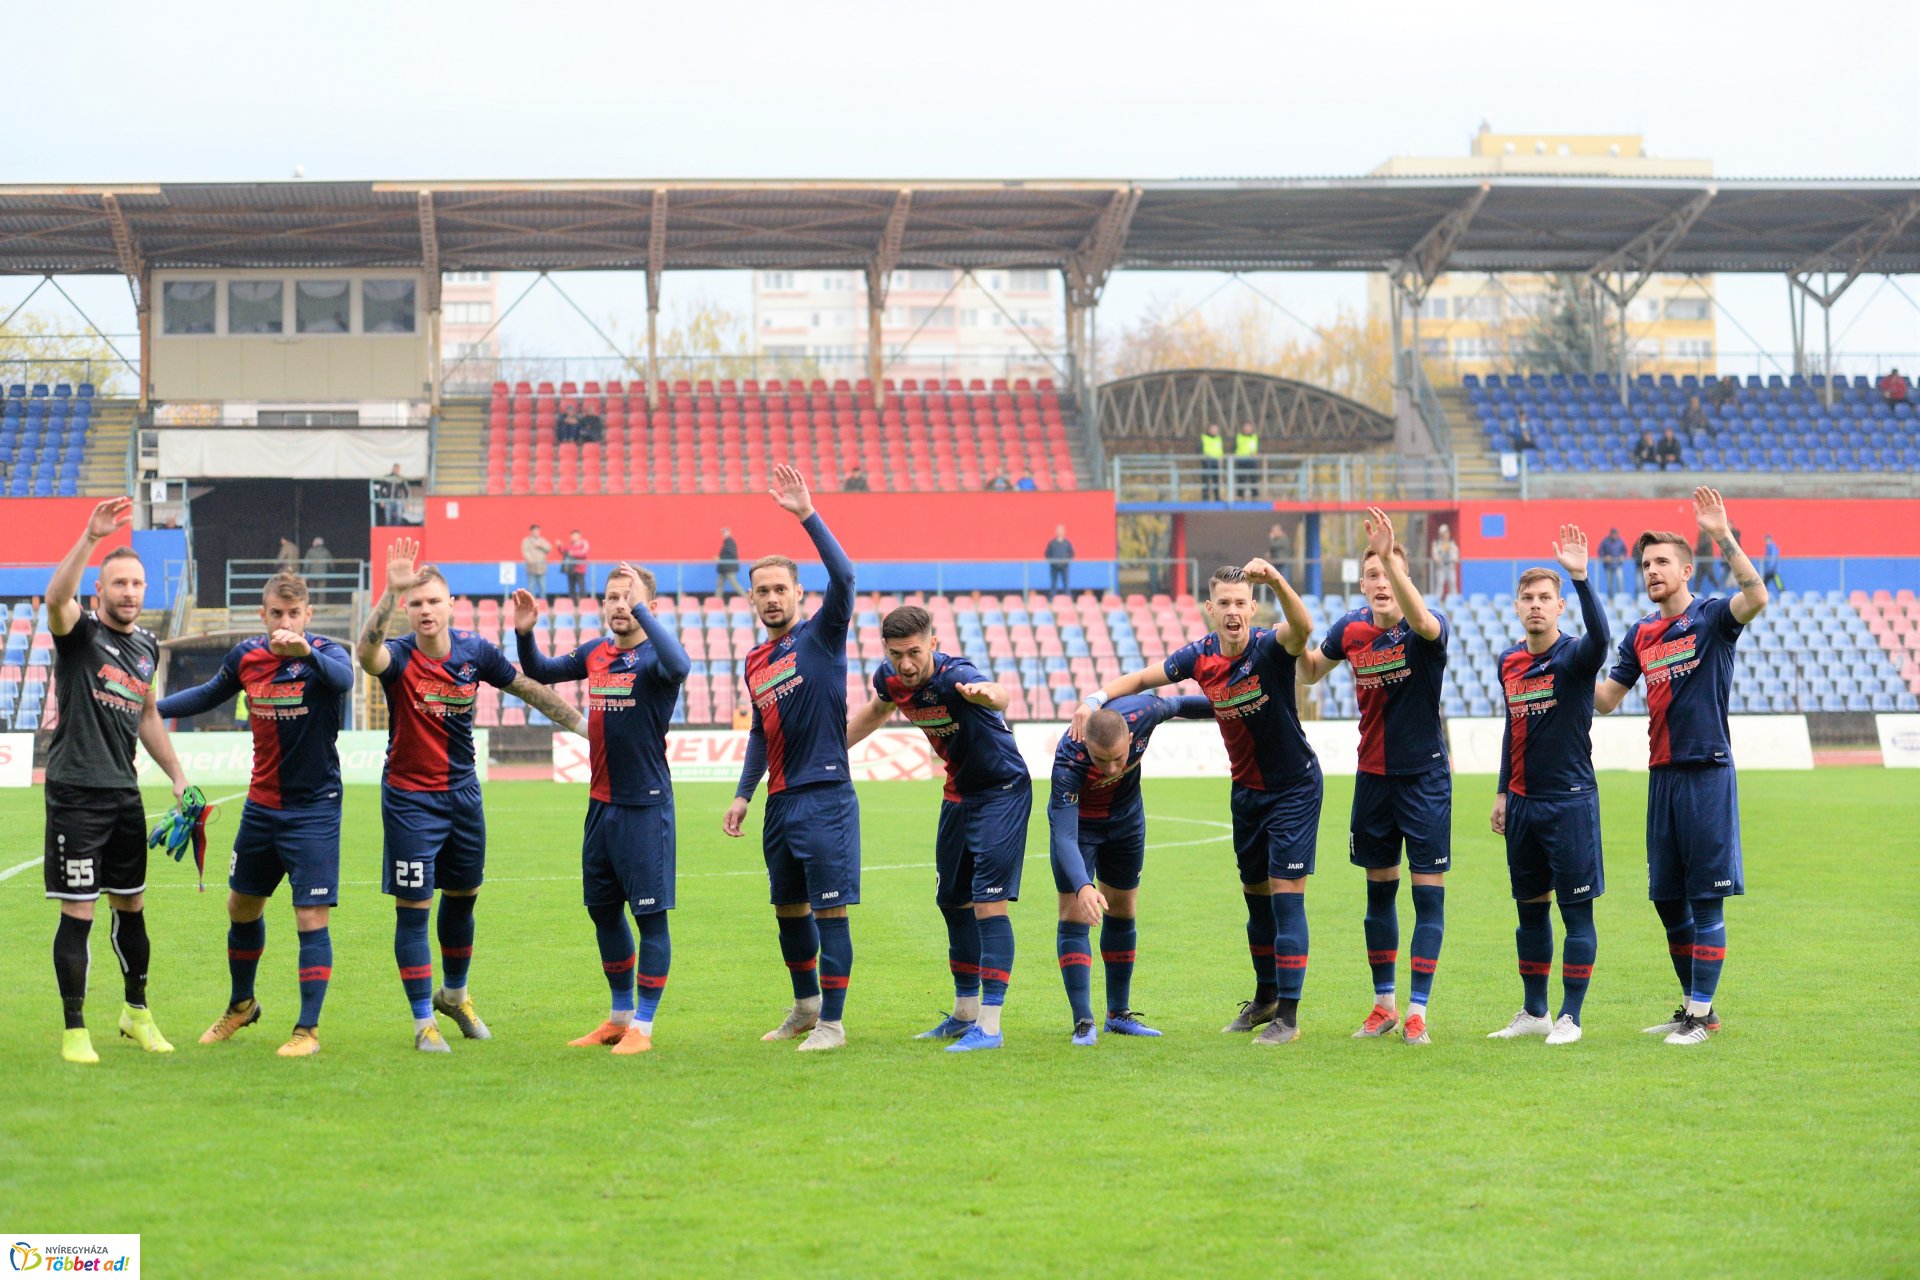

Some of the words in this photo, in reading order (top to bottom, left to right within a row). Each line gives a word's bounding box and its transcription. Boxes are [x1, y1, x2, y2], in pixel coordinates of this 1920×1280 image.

[97, 663, 152, 696] REVES
[907, 705, 950, 722] EVESZ
[1287, 862, 1305, 870] JAKO
[66, 858, 95, 888] 55
[395, 860, 424, 888] 23
[1714, 880, 1732, 888] JAKO
[310, 888, 329, 896] JAKO
[1573, 885, 1591, 894] JAKO
[821, 891, 840, 900] JAKO
[638, 898, 656, 906] JAKO
